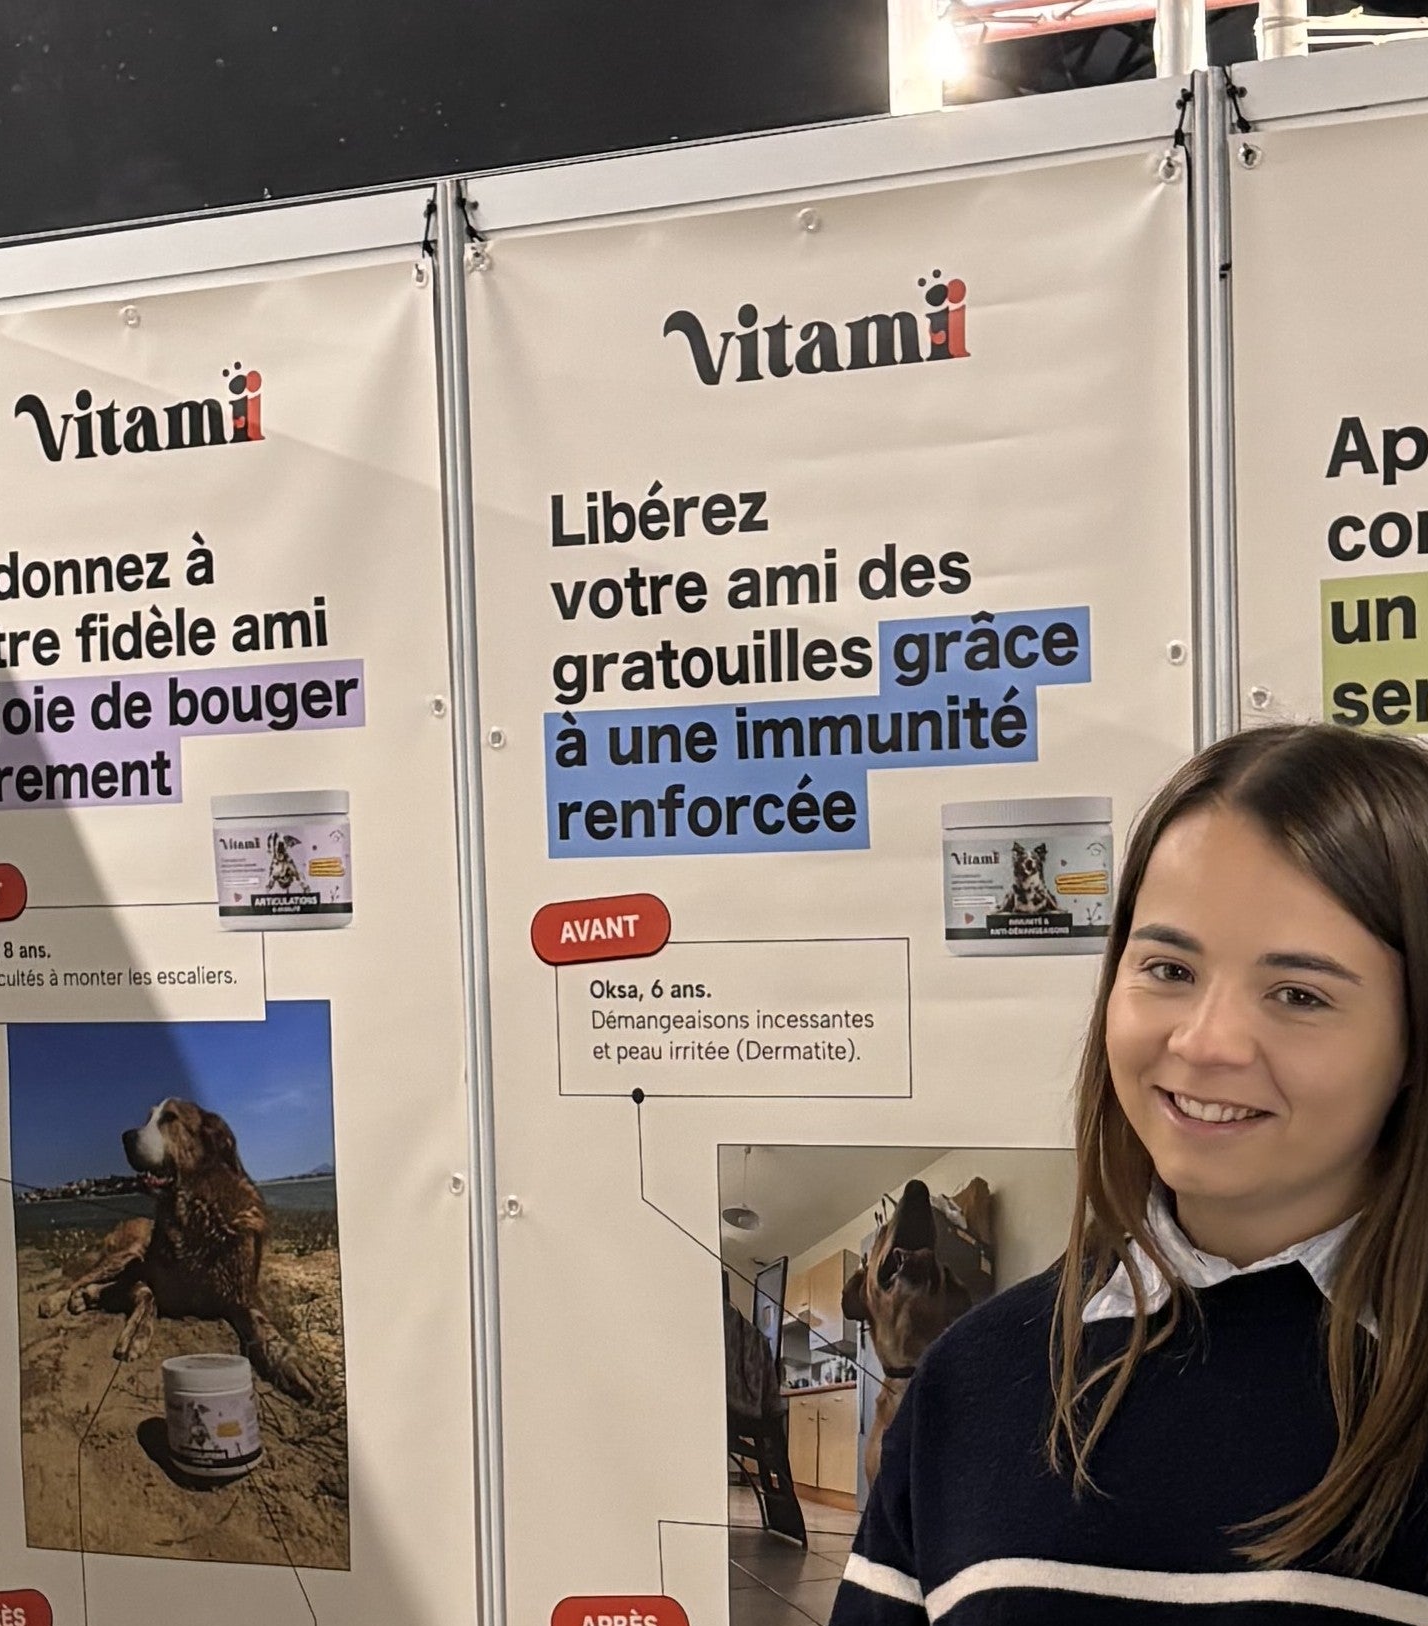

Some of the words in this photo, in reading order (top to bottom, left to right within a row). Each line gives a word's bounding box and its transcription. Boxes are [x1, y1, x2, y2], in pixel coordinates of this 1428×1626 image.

[551, 479, 769, 548] Libérez
[185, 530, 215, 587] à
[550, 566, 708, 621] votre
[727, 547, 838, 610] ami
[858, 542, 972, 601] des
[75, 604, 216, 663] fidèle
[232, 595, 328, 653] ami
[1330, 595, 1417, 645] un
[552, 625, 876, 707] gratouilles
[893, 607, 1082, 687] grâce
[90, 680, 153, 731] de
[168, 676, 359, 732] bouger
[555, 710, 588, 768] à
[608, 721, 718, 766] une
[734, 684, 1028, 760] immunité
[557, 773, 857, 841] renforcée
[3, 941, 14, 959] 8
[19, 944, 52, 959] ans.
[560, 914, 640, 944] AVANT
[49, 968, 59, 987] à
[63, 969, 124, 987] monter
[128, 966, 153, 986] les
[156, 965, 238, 985] escaliers.
[589, 979, 644, 1003] Oksa,
[650, 978, 664, 999] 6
[670, 983, 712, 999] ans.
[591, 1009, 750, 1035] Démangeaisons
[756, 1009, 875, 1030] incessantes
[592, 1042, 612, 1060] et
[616, 1045, 663, 1065] peau
[669, 1040, 730, 1061] irritée
[736, 1037, 861, 1063] (Dermatite).
